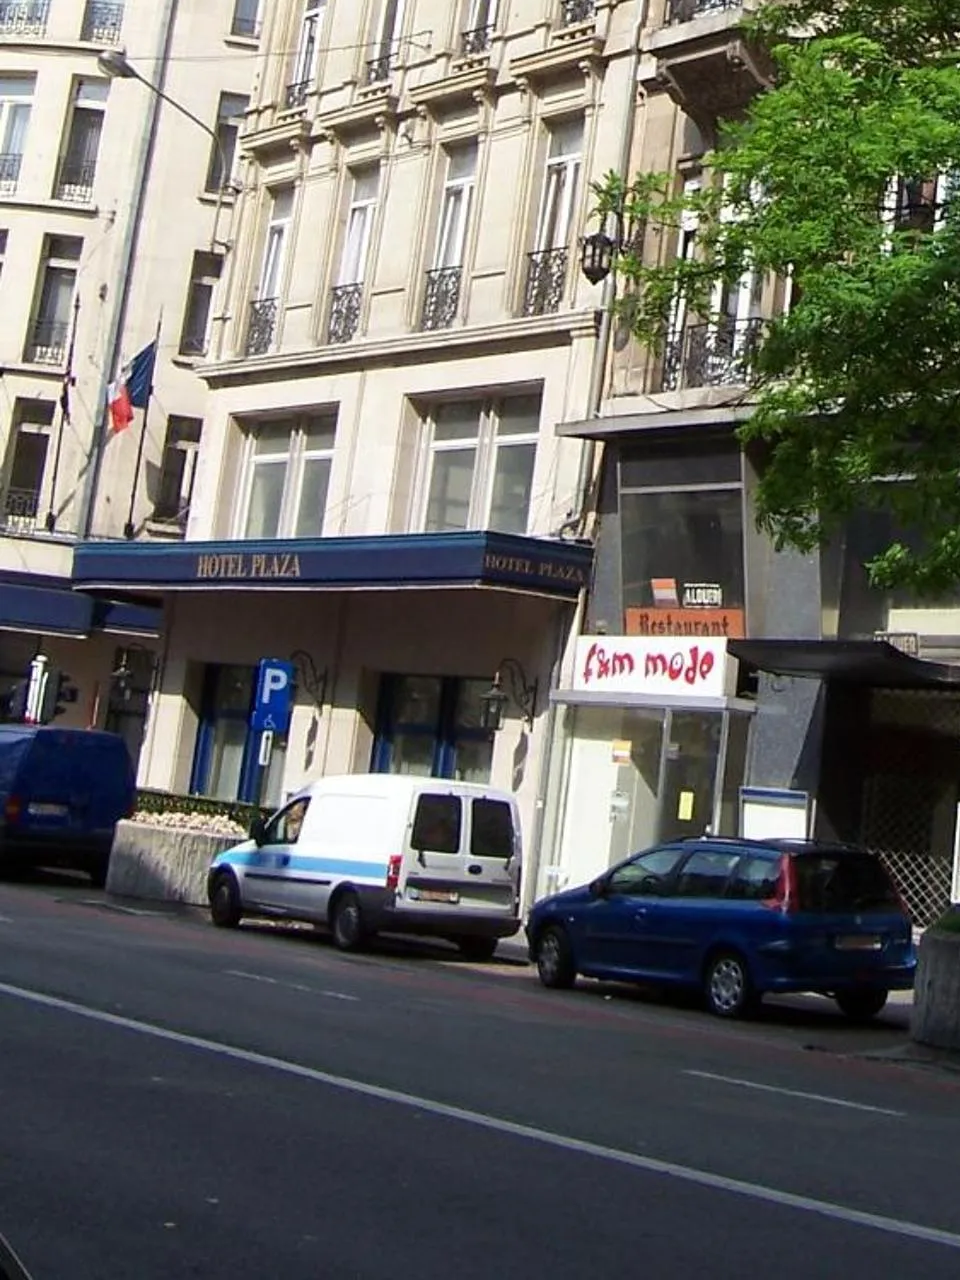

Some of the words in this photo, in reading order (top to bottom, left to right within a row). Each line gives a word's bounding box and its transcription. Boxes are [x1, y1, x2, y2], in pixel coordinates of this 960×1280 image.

[197, 553, 247, 578] HOTEL
[250, 553, 301, 578] PLAZA
[485, 554, 534, 576] HOTEL
[540, 562, 584, 582] PLAZA
[639, 613, 730, 636] Restaurant
[645, 646, 714, 685] mode
[262, 668, 288, 704] P
